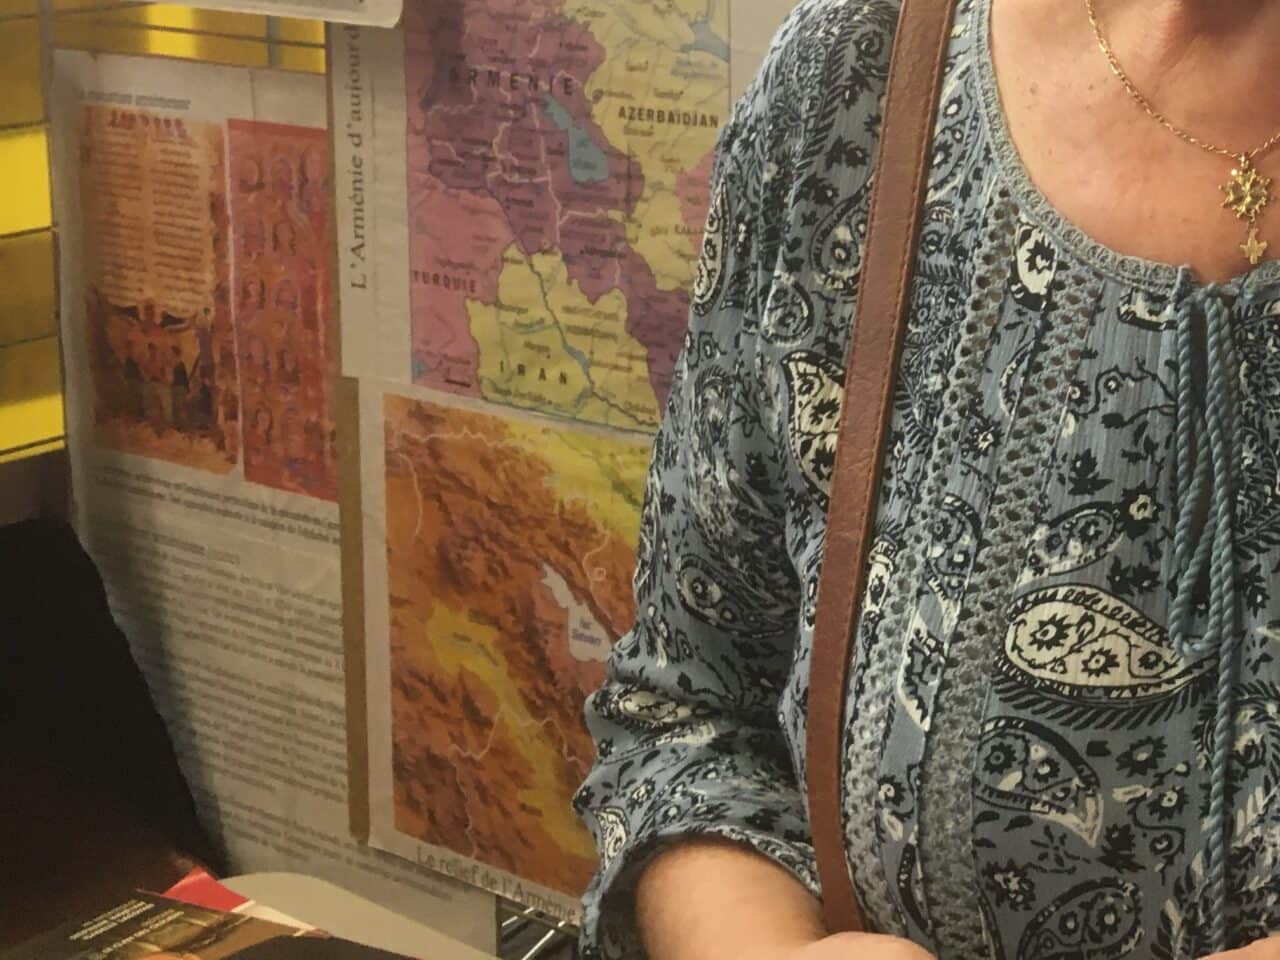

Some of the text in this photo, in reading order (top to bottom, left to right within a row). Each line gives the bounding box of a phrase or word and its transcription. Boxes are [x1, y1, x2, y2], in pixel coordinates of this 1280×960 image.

[349, 154, 367, 290] L'Arménie
[411, 269, 477, 293] TURQUIE
[499, 360, 569, 385] IRAN
[416, 845, 435, 867] Le
